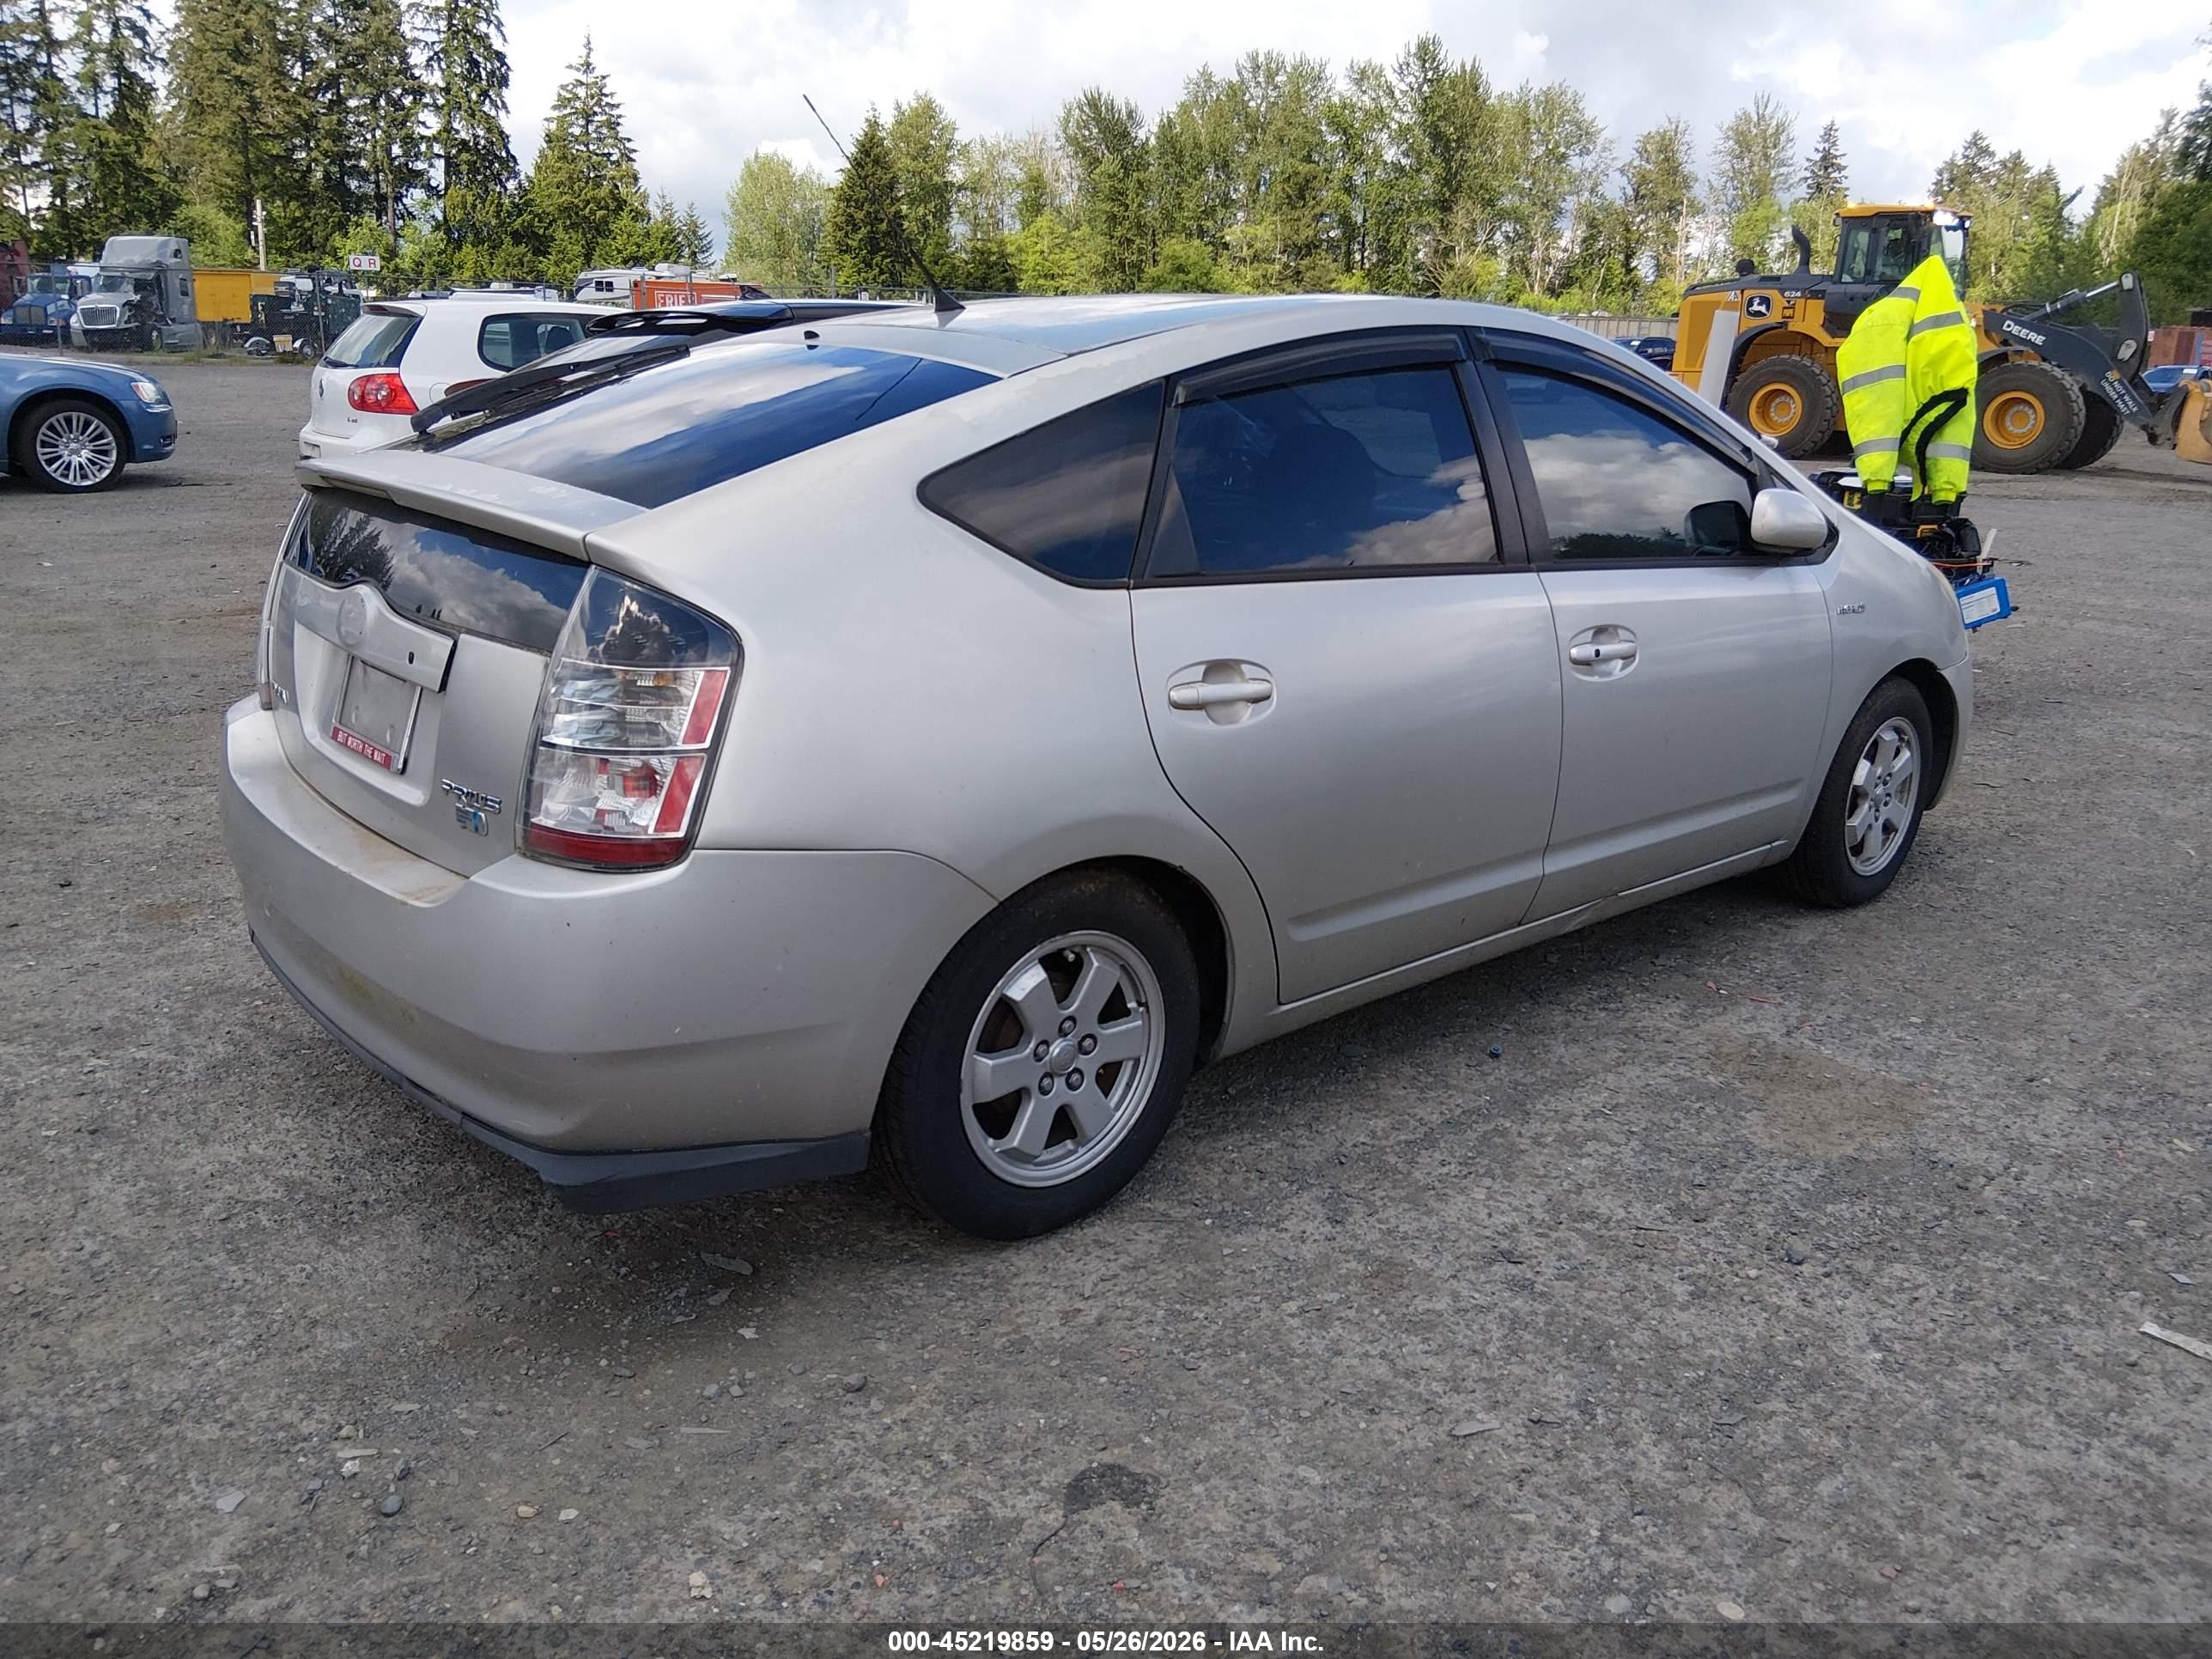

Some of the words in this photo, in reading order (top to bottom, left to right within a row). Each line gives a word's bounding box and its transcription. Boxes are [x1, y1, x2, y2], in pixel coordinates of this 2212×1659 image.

[352, 257, 362, 268] Q
[368, 258, 376, 268] R
[2002, 319, 2046, 345] DEERE
[2100, 378, 2118, 400] UNDER
[2114, 398, 2130, 416] MAST
[2104, 370, 2116, 382] DO
[2112, 380, 2126, 395] NOT
[2123, 393, 2139, 412] WALK
[337, 730, 348, 744] BUT
[347, 735, 364, 754] WORTH
[363, 744, 374, 758] THE
[373, 749, 386, 764] WAIT
[441, 778, 502, 814] PRIUS
